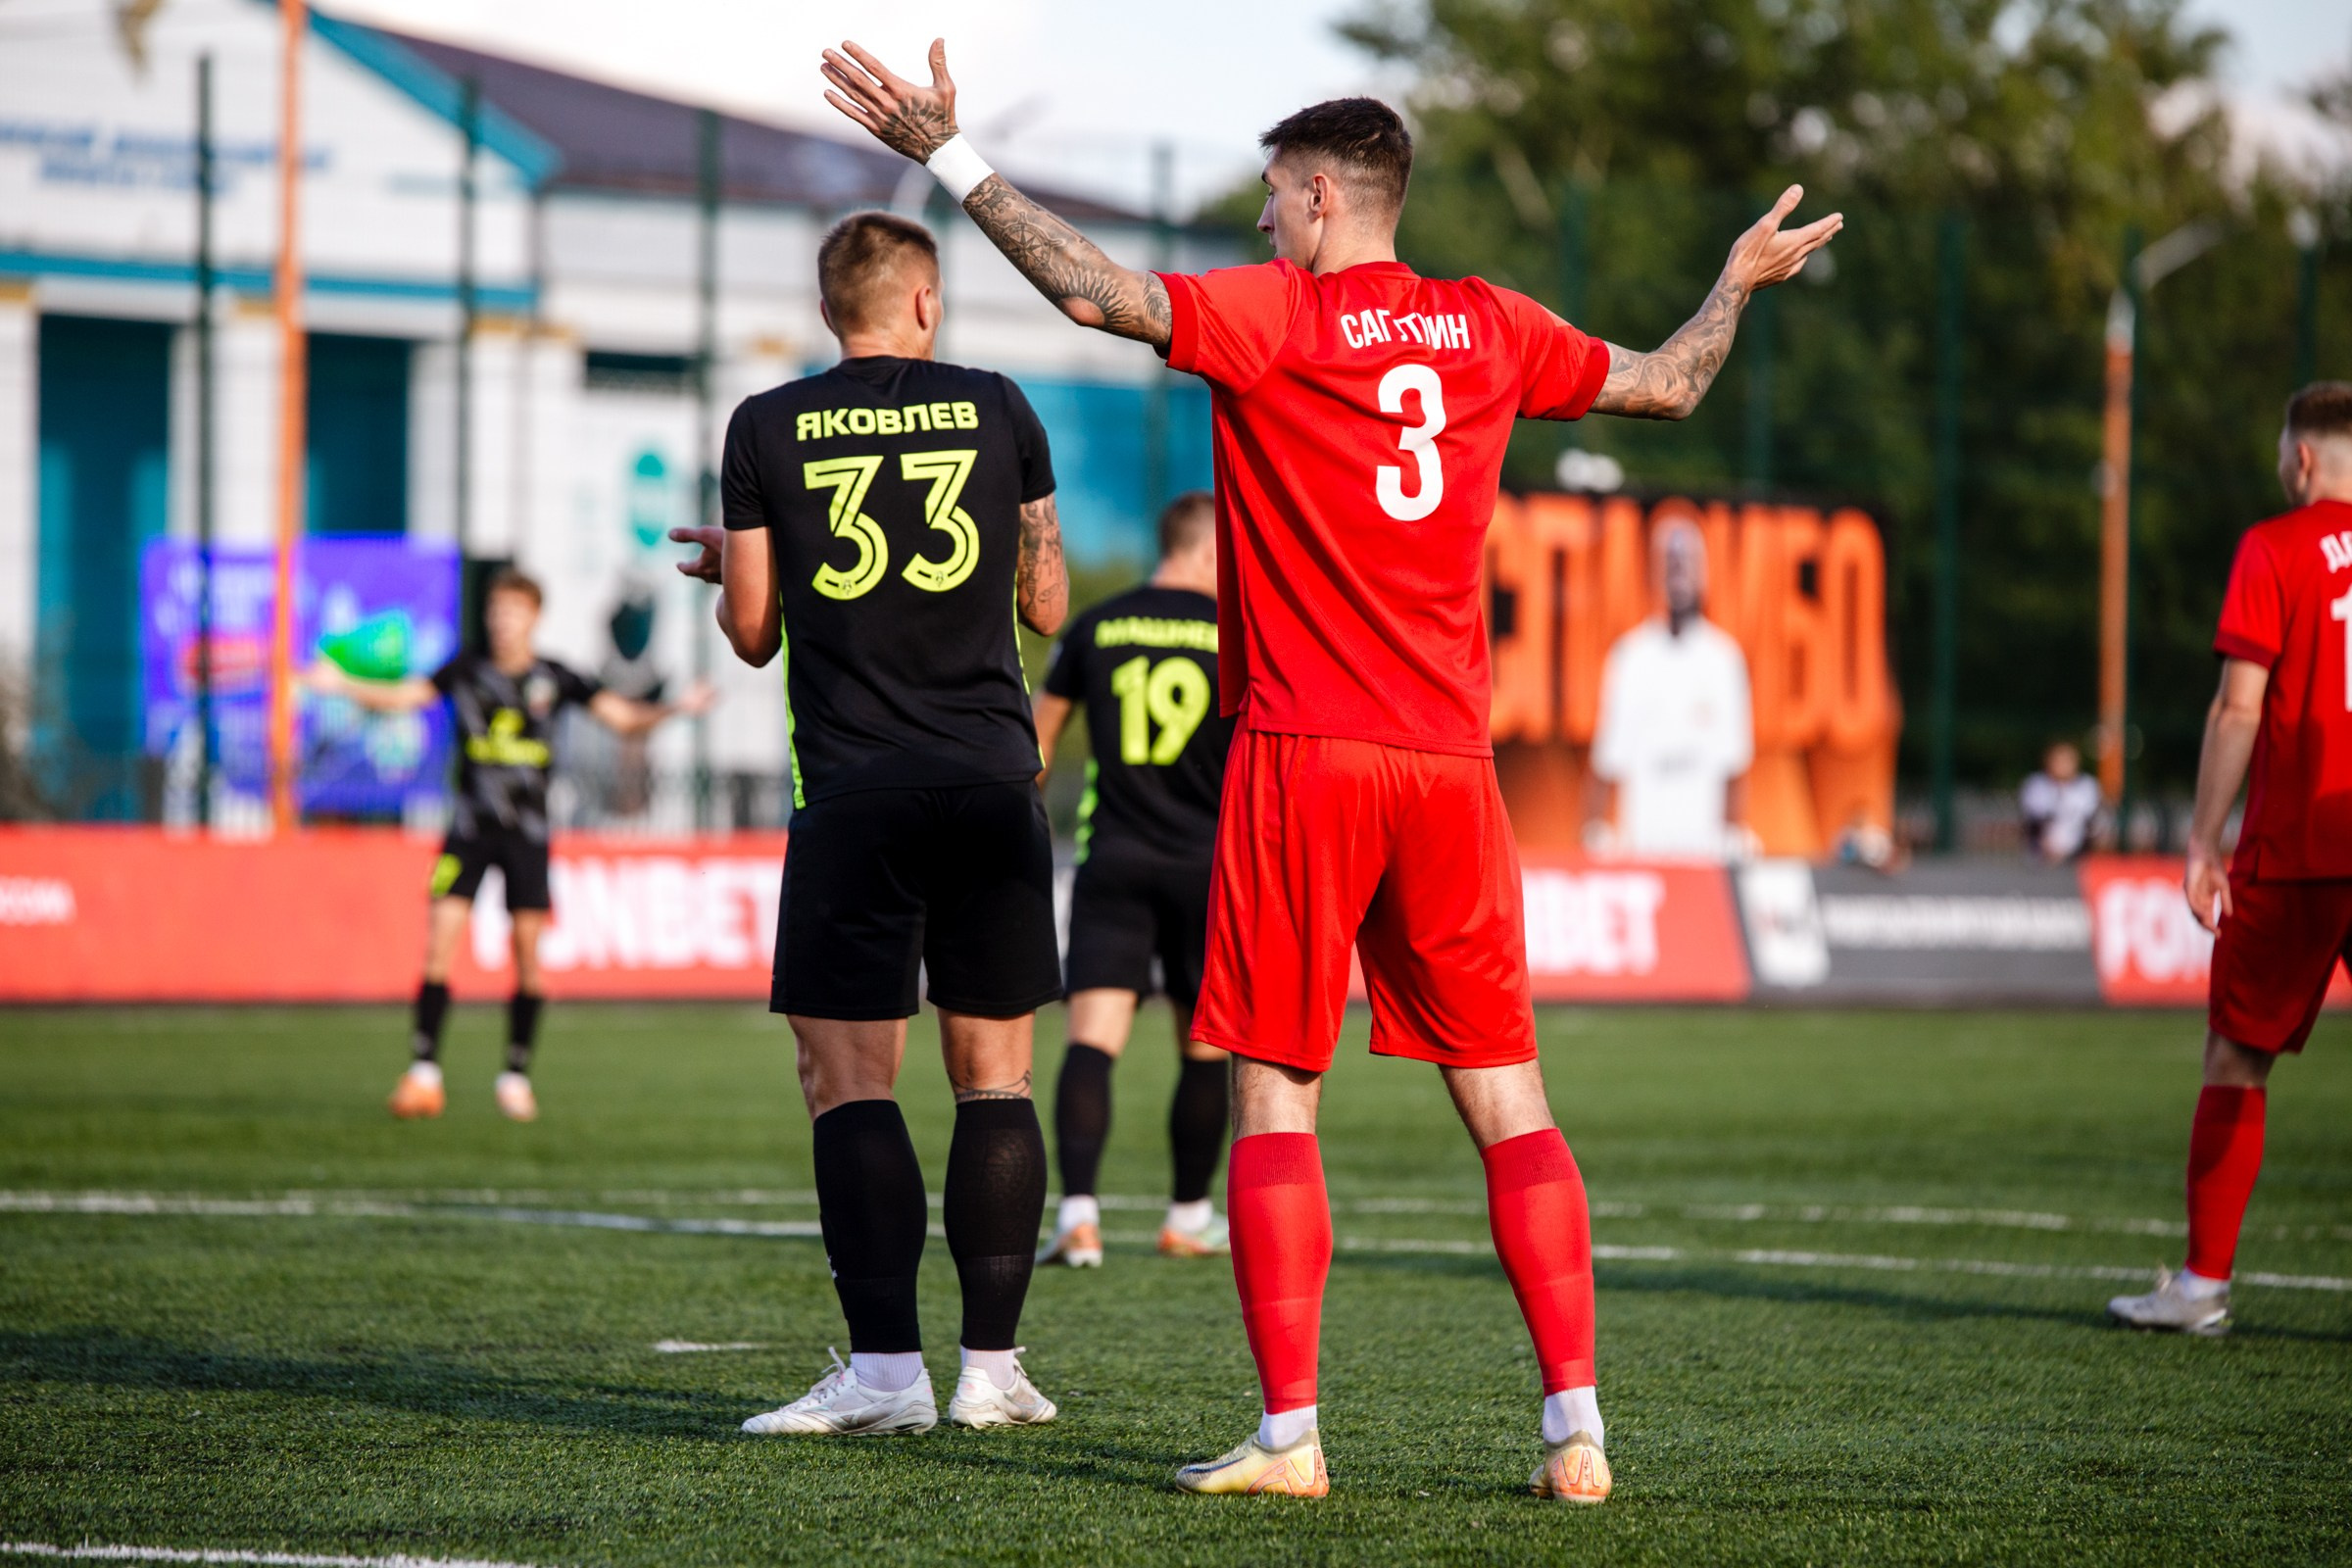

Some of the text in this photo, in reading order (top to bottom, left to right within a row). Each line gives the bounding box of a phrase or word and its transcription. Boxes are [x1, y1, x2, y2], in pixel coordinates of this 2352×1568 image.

[796, 401, 979, 441] ЯКОВЛЕВ
[1376, 364, 1446, 521] 3
[803, 449, 980, 600] 33
[1111, 655, 1210, 765] 19
